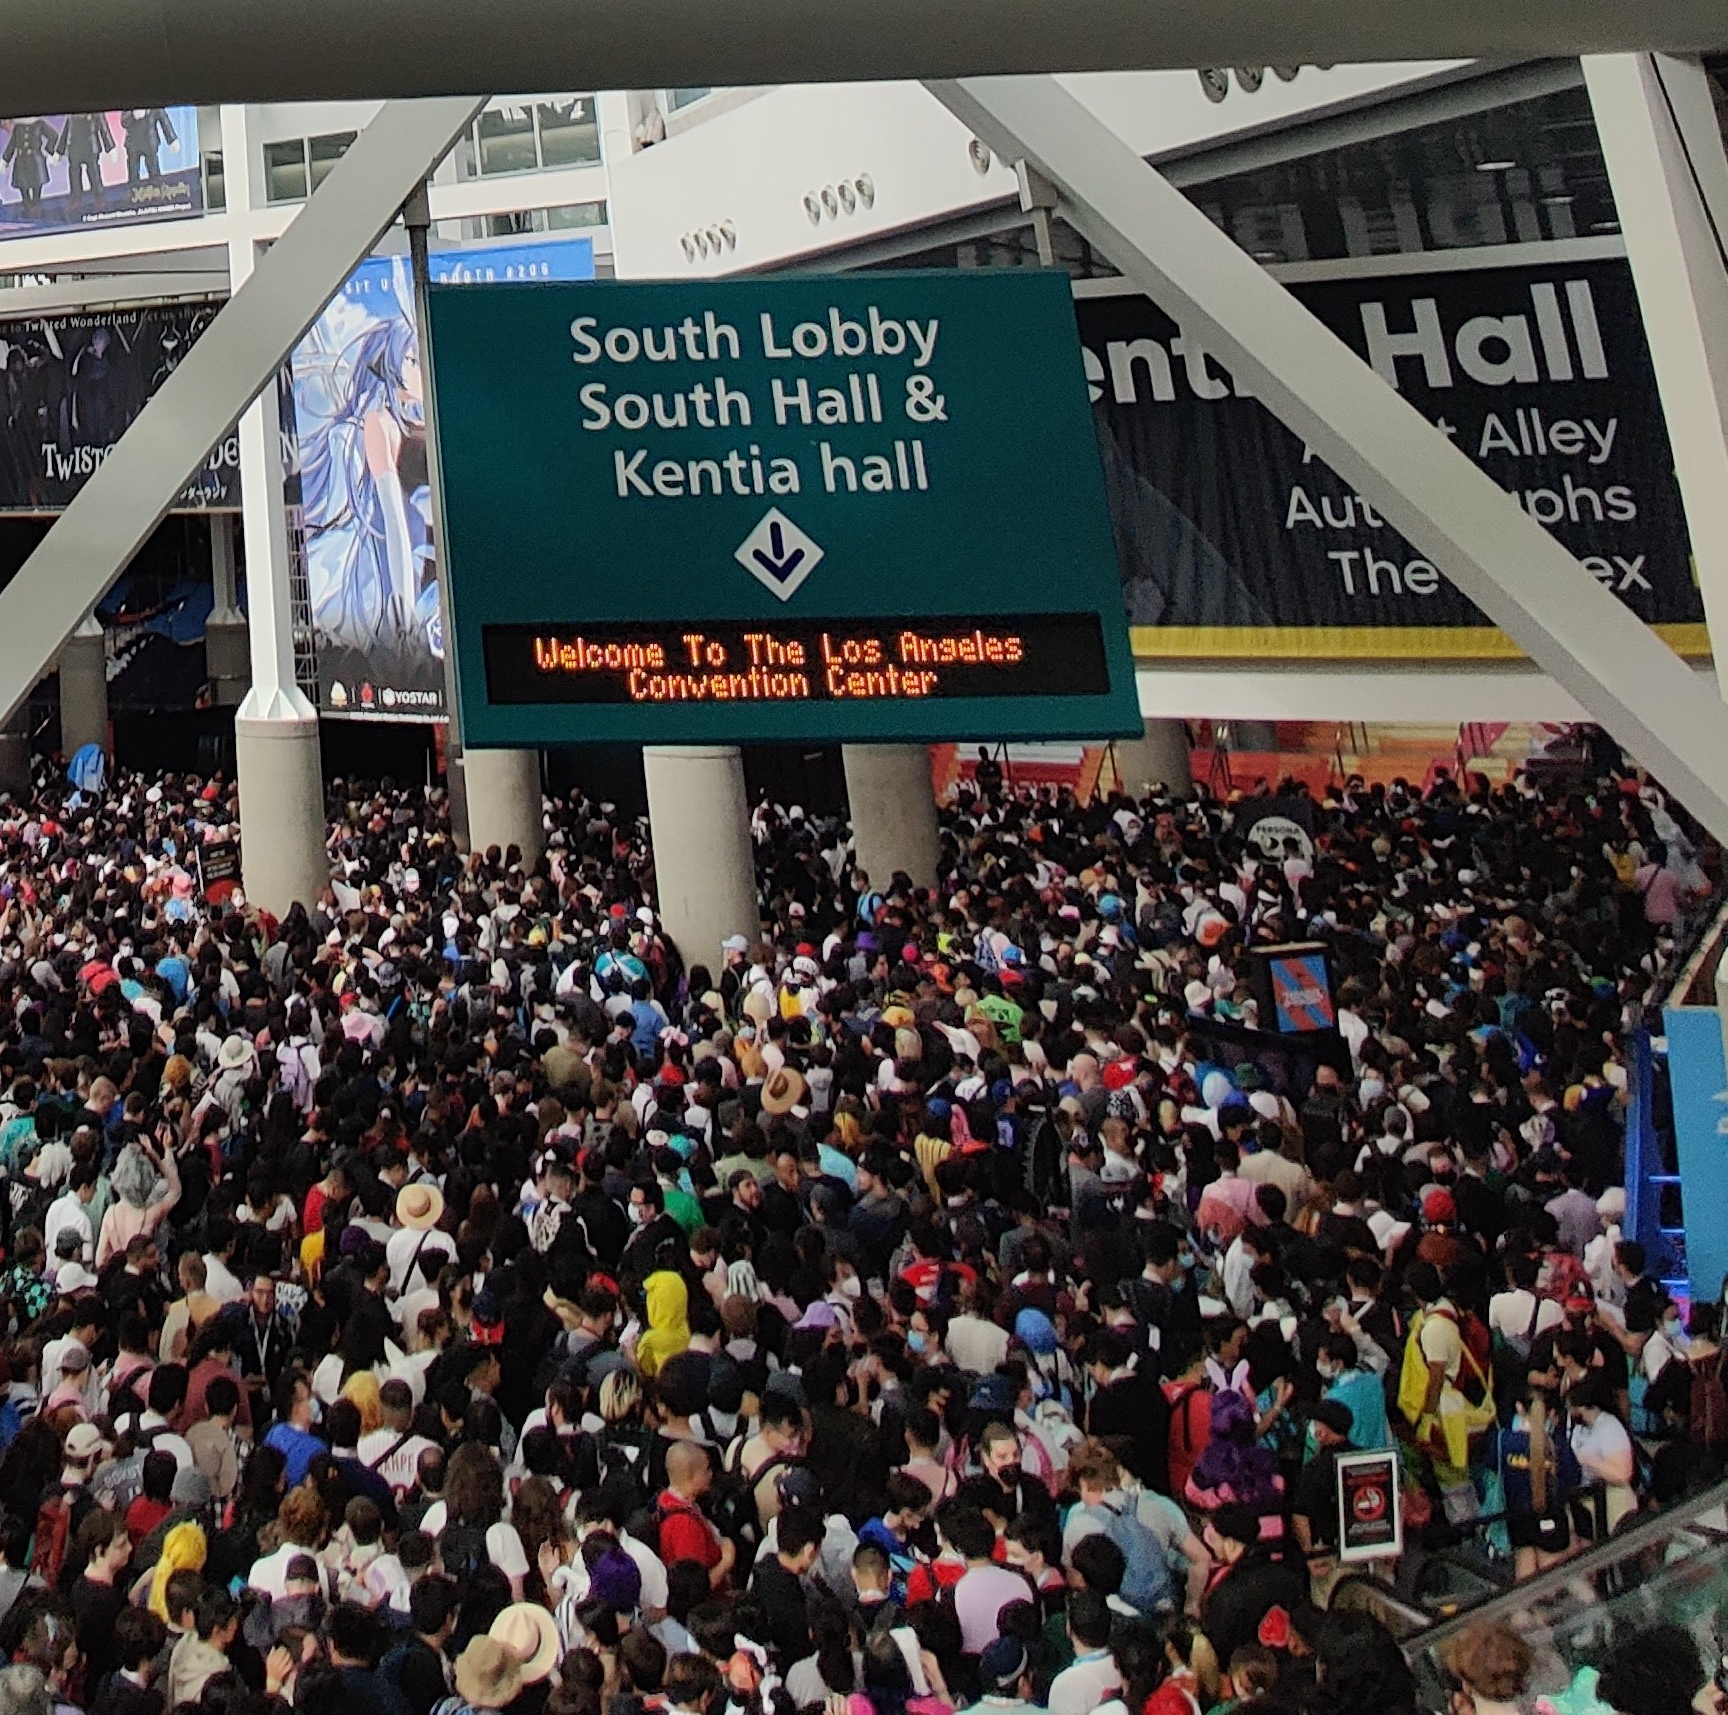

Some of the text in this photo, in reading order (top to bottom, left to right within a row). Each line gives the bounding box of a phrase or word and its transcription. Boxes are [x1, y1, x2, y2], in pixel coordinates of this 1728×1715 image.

[70, 311, 137, 328] Wonderland
[571, 306, 939, 367] South Lobby
[1360, 279, 1609, 389] Hall
[579, 373, 948, 430] South Hall &
[1478, 407, 1618, 464] Alley
[614, 439, 929, 498] Kentia hall
[1327, 547, 1440, 596] The
[534, 630, 1024, 669] Welcome To The Los Angeles
[395, 690, 438, 706] YOSTAR
[627, 663, 938, 700] Convention Center
